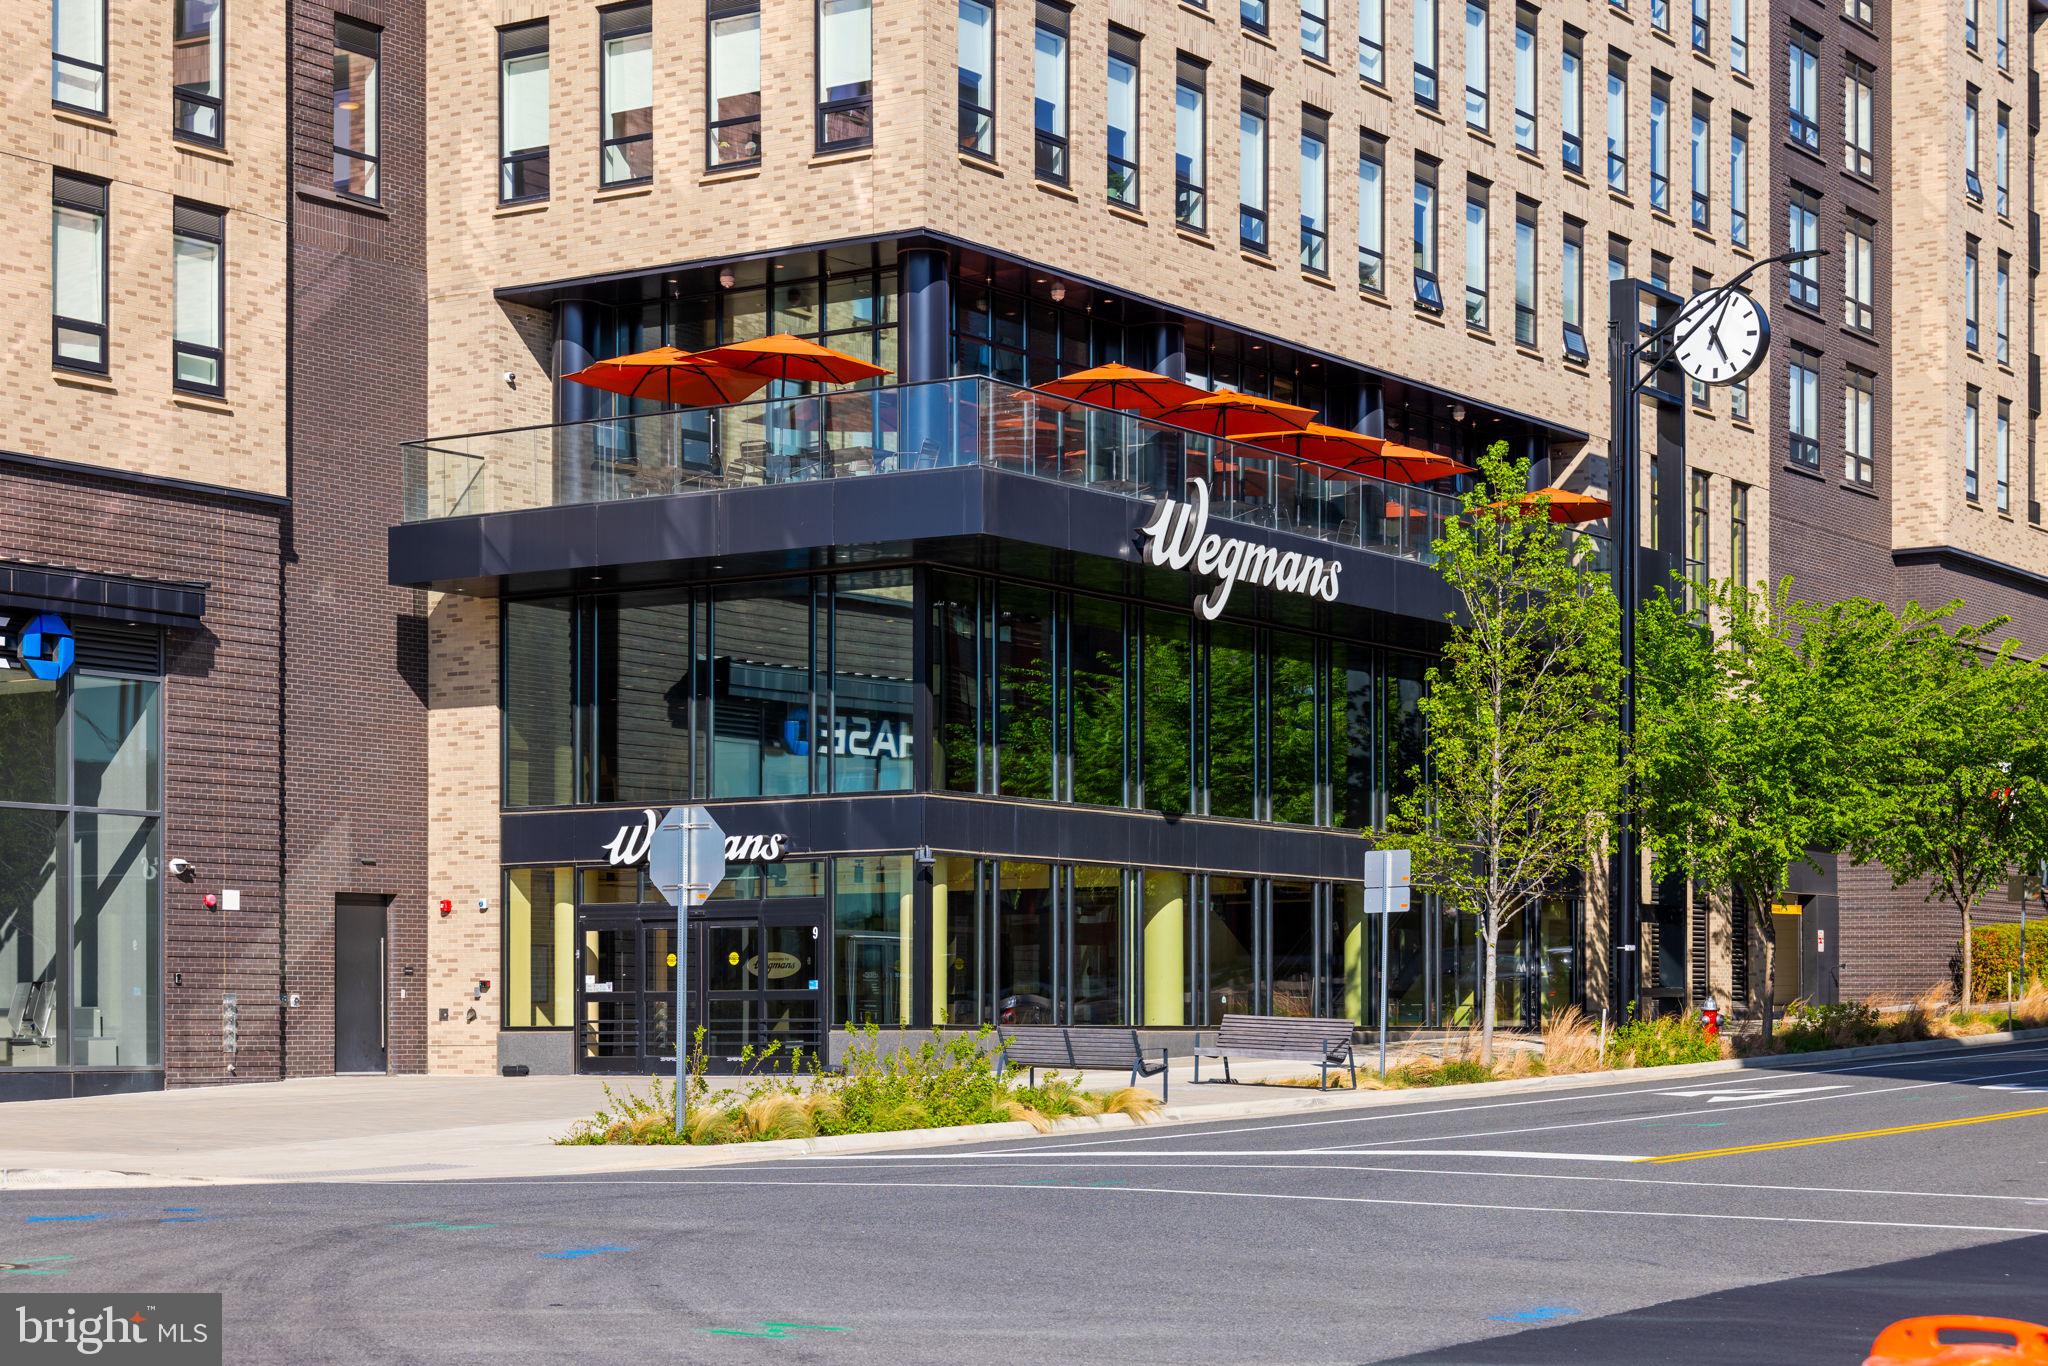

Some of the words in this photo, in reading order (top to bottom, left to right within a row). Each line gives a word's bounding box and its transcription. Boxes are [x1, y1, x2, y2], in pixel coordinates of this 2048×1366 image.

[1142, 477, 1343, 621] Wegmans
[601, 808, 782, 865] Wans
[812, 926, 818, 939] 9
